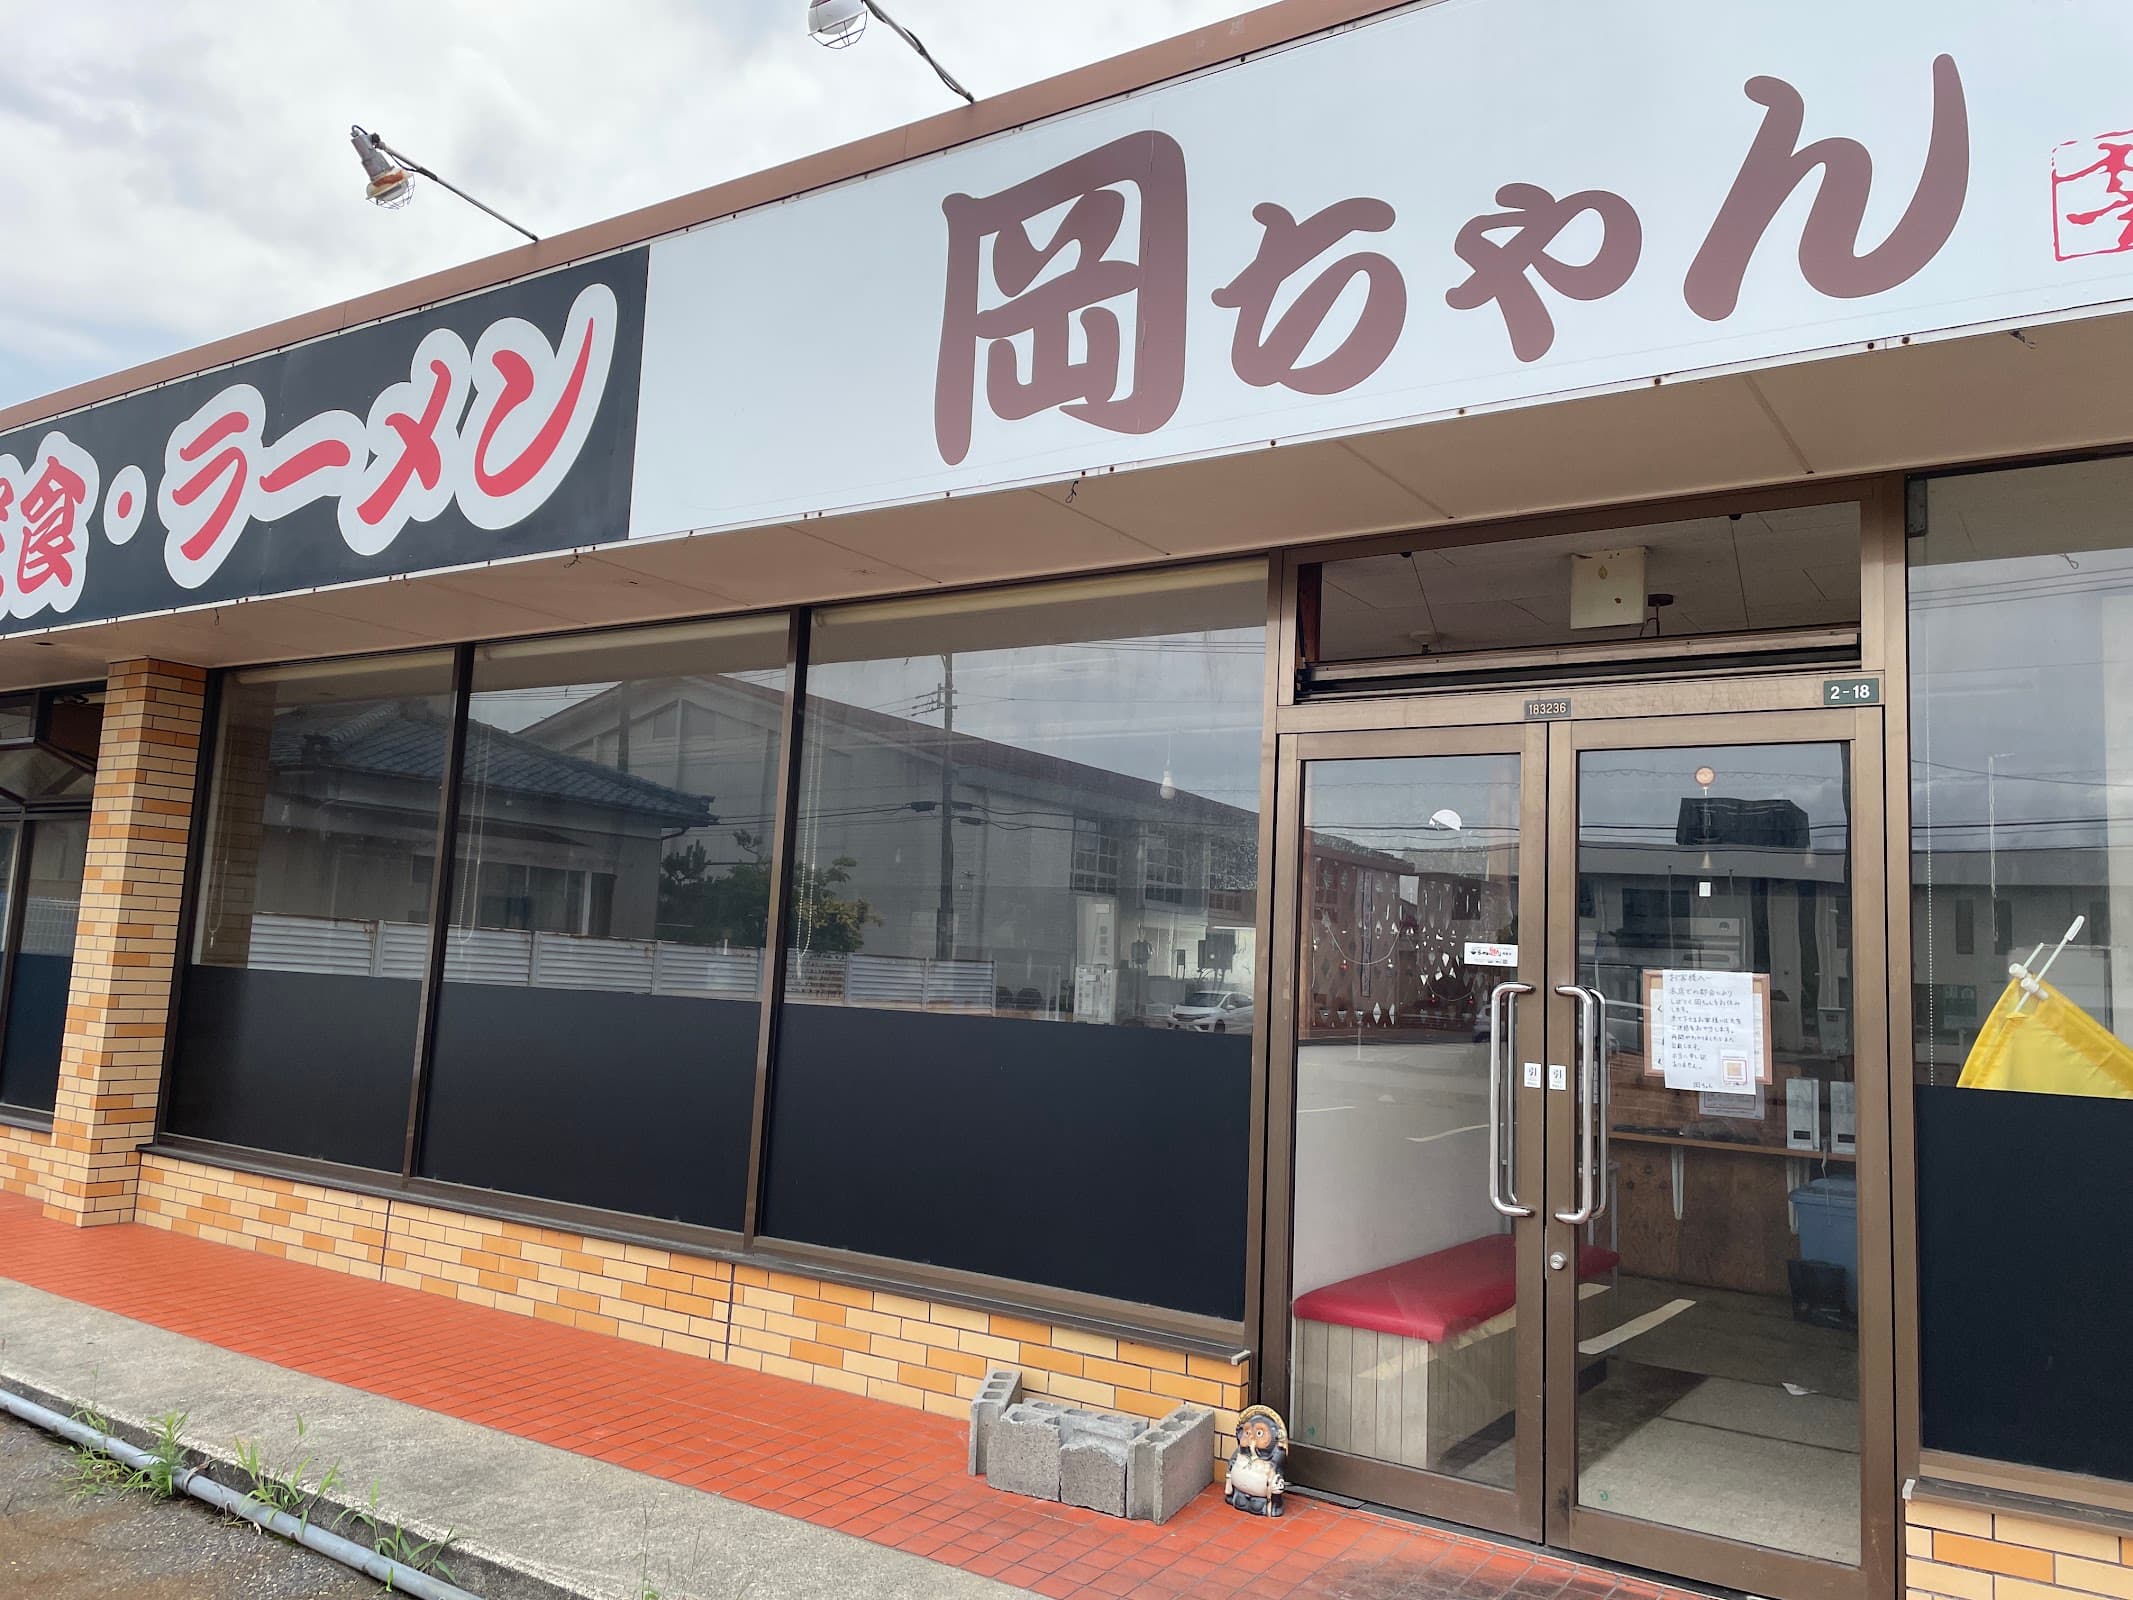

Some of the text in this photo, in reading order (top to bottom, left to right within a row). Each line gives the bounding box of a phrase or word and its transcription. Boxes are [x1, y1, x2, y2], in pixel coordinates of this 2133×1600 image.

[935, 53, 1969, 465] 岡ちゃん
[0, 295, 608, 610] 食・ラーメン
[1529, 702, 1566, 715] 183236
[1830, 684, 1870, 700] 2-18
